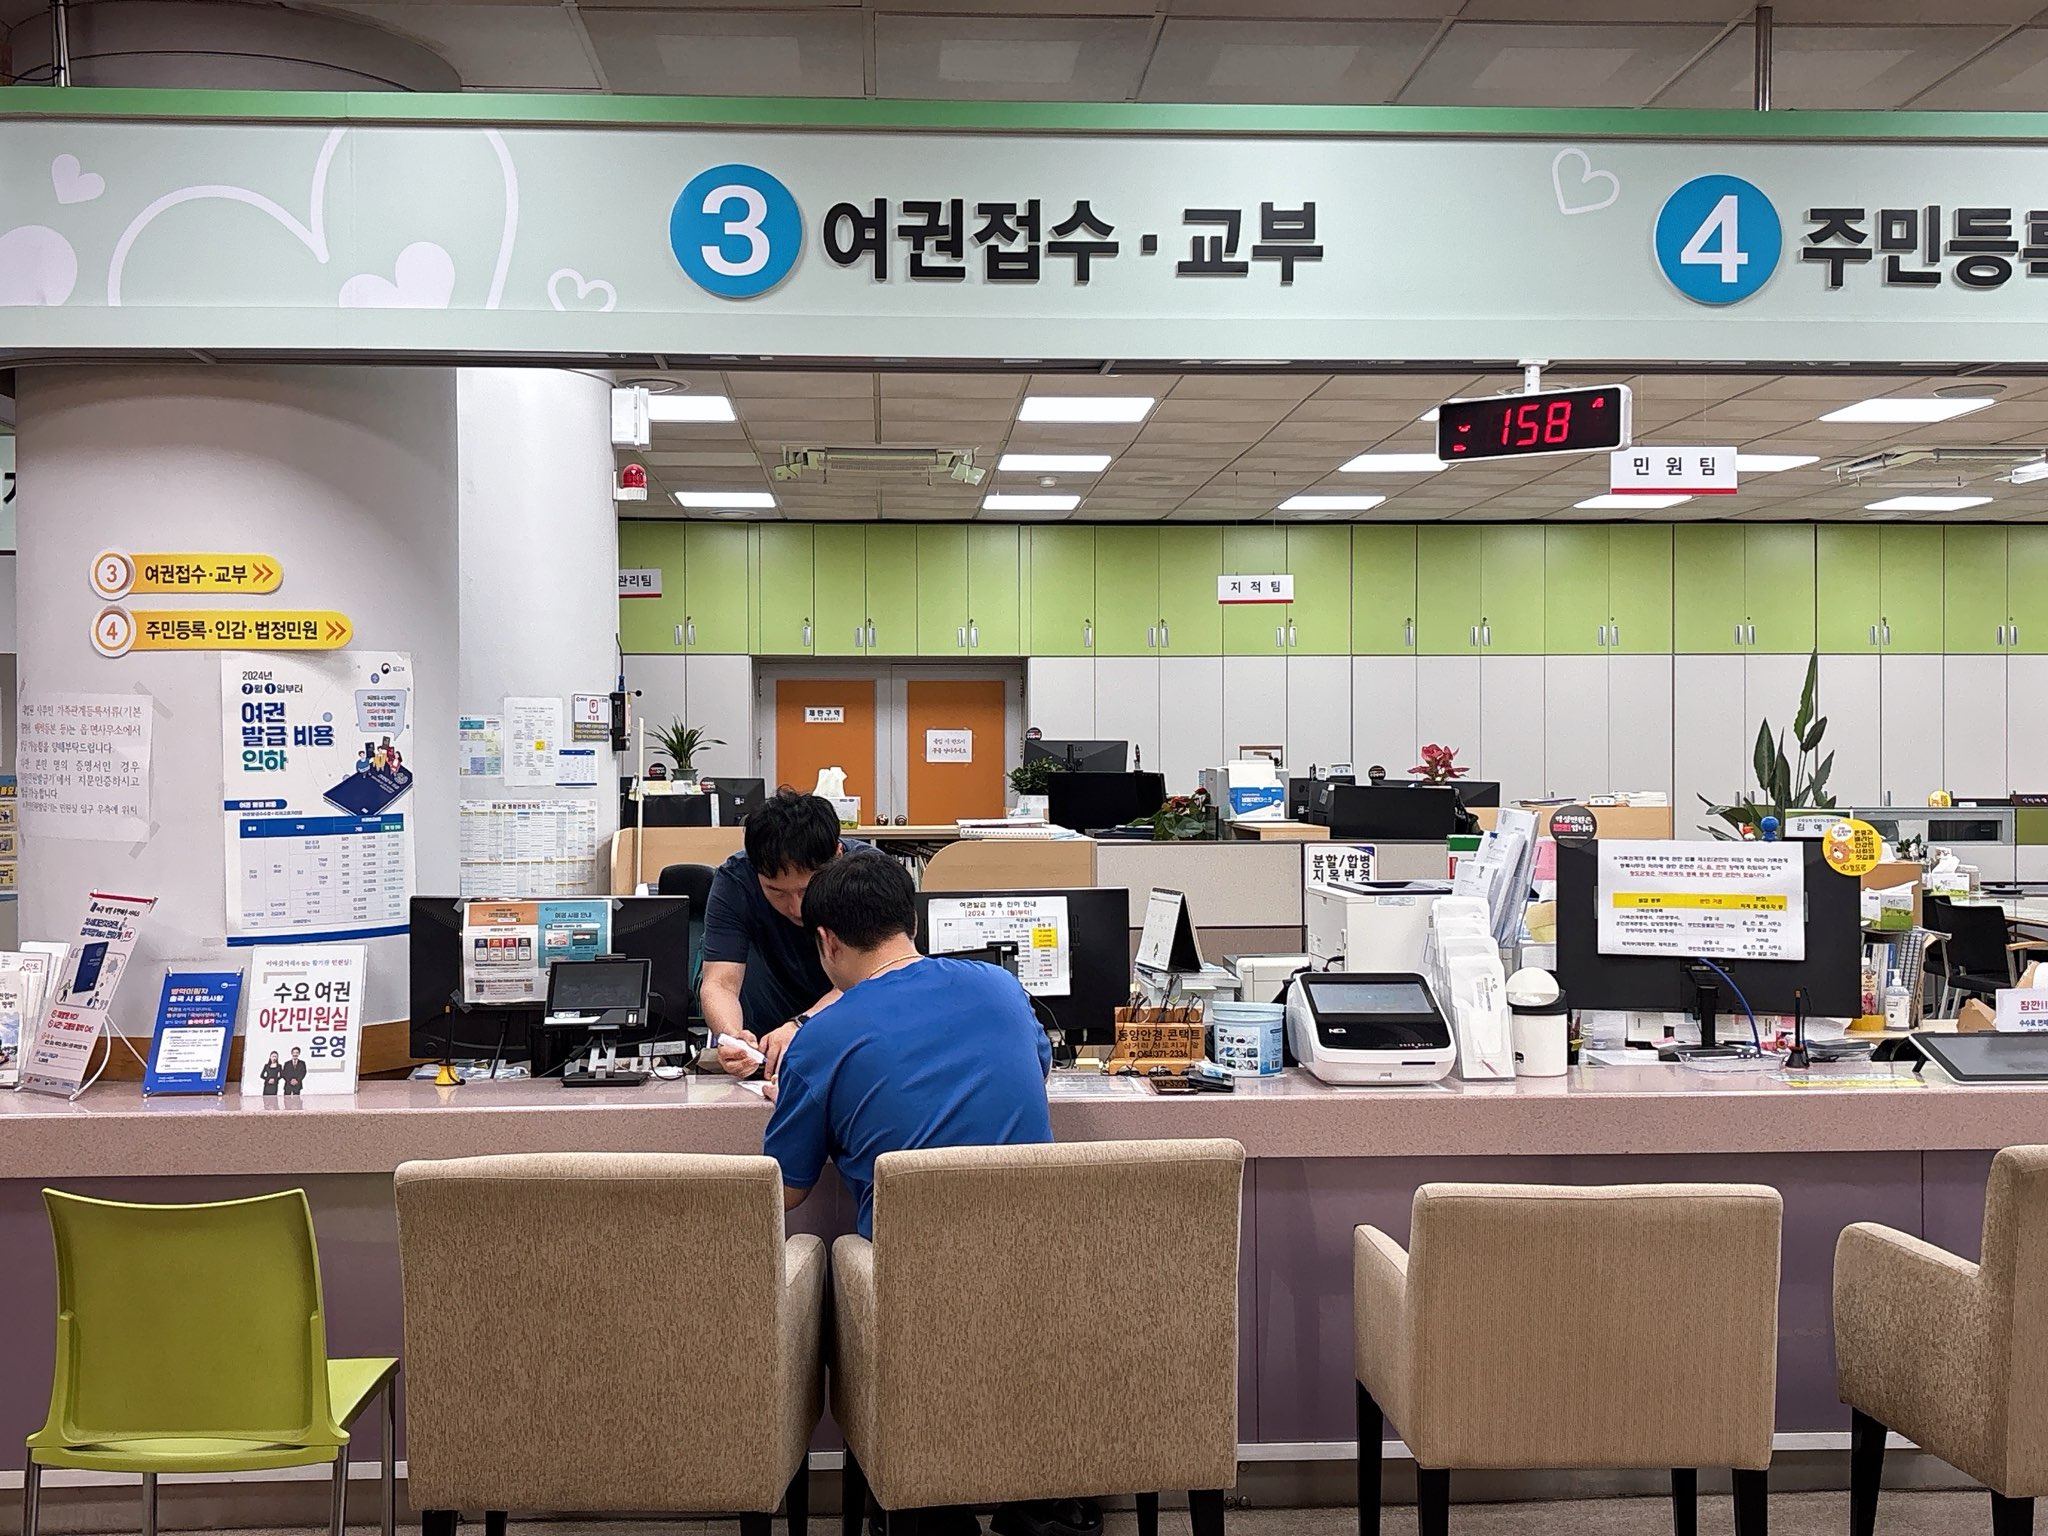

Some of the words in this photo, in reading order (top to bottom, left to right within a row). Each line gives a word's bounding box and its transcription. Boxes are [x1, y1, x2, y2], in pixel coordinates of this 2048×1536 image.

[701, 185, 770, 277] 3
[1681, 194, 1749, 283] 4
[1499, 400, 1573, 447] 158
[106, 565, 118, 583] 3
[145, 564, 248, 585] 여권접수·교부
[106, 621, 118, 640] 4
[146, 620, 318, 641] 주민등록·인감·법정민원
[242, 671, 273, 681] 2024년
[242, 683, 263, 694] 7월
[265, 683, 303, 694] 1일부터
[242, 702, 286, 724] 여권
[242, 726, 289, 748] 발급
[293, 725, 335, 747] 비용
[76, 760, 111, 772] 증명서인
[120, 761, 140, 773] 경우
[242, 750, 288, 772] 인하
[1312, 854, 1371, 869] 분할/합병
[959, 901, 986, 909] 여권발급
[990, 901, 1003, 909] 비용
[1023, 900, 1037, 908] 안내
[274, 982, 311, 1003] 수요
[315, 981, 351, 1003] 여권
[259, 1006, 349, 1033] 야간민원실
[309, 1035, 347, 1058] 운영
